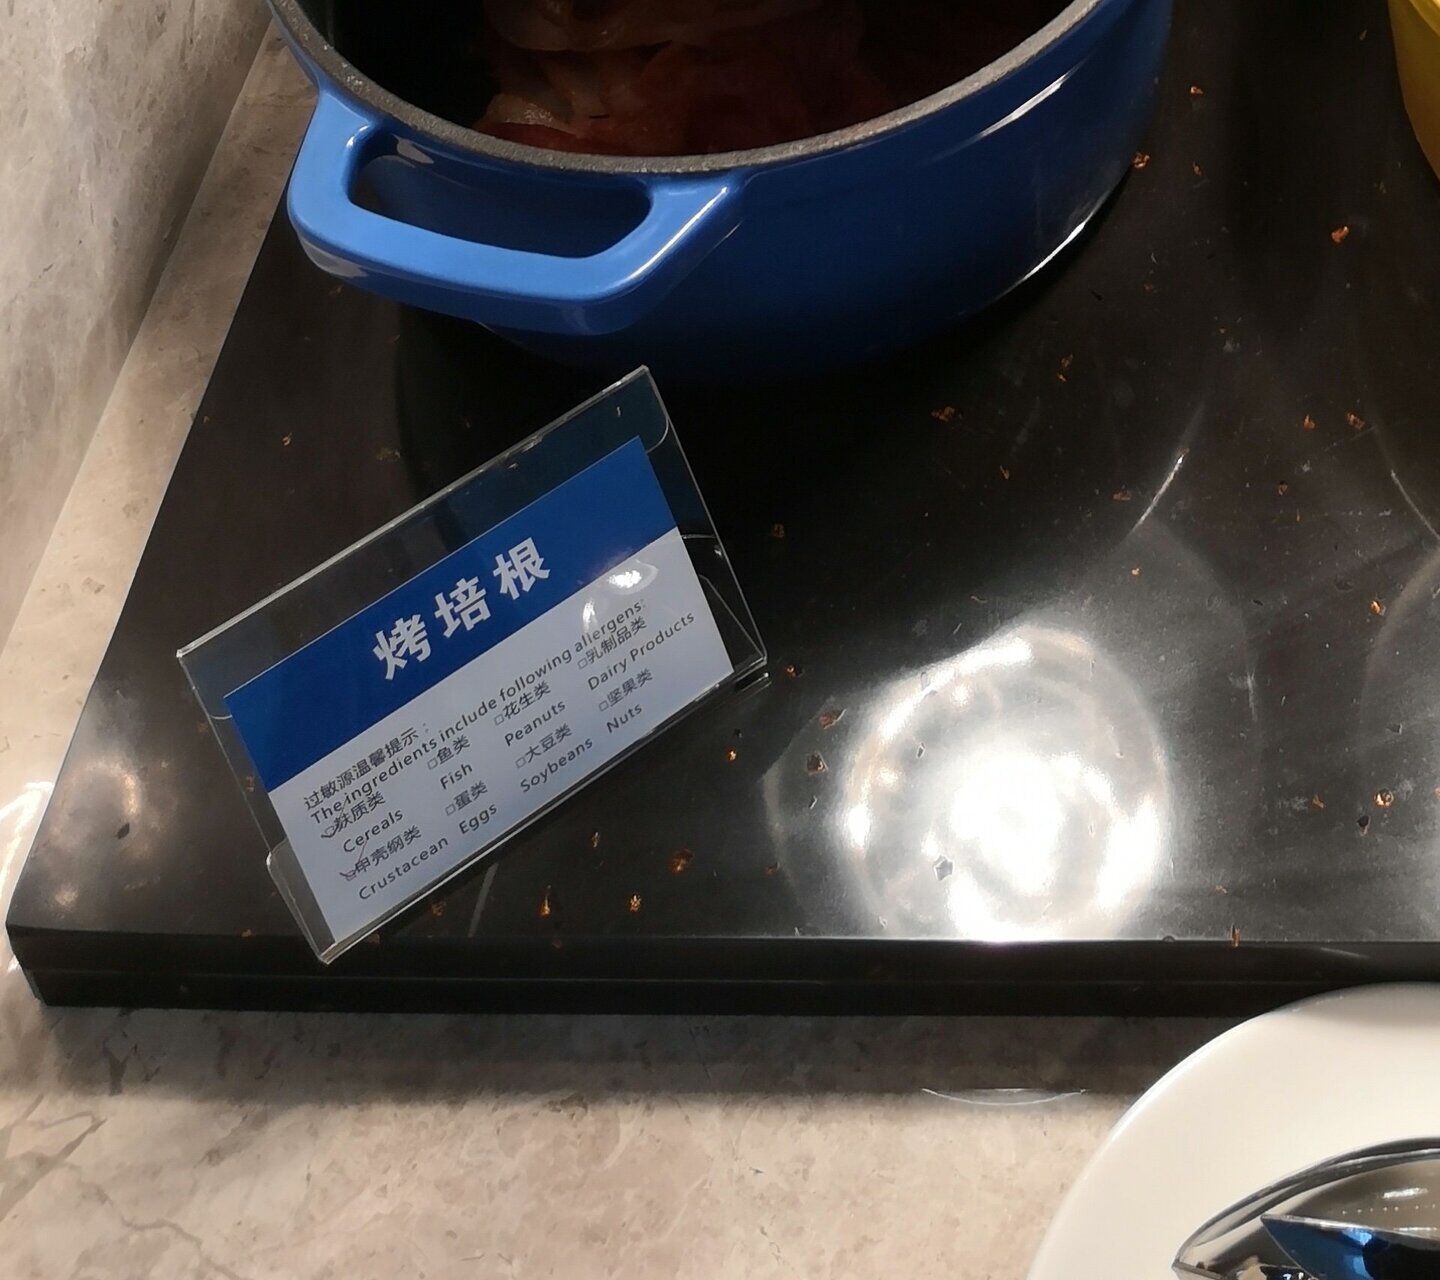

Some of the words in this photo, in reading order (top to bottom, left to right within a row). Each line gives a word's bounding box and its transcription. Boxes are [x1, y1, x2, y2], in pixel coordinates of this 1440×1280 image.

[373, 538, 551, 680] 烤培根
[586, 616, 648, 665] 乳制品类
[587, 658, 628, 691] Dairy
[630, 612, 695, 662] Products
[503, 681, 551, 721] 花生类
[608, 669, 653, 707] 坚果类
[311, 800, 342, 825] The
[344, 737, 438, 803] ingredients
[439, 697, 498, 742] include
[499, 649, 573, 702] following
[574, 599, 647, 653] allergens:
[504, 701, 567, 747] Peanuts
[606, 704, 643, 735] Nuts
[436, 734, 471, 766] 鱼类
[520, 737, 594, 793] Soybeans
[526, 723, 573, 765] 大豆类
[439, 762, 474, 790] Fish
[453, 781, 489, 811] 蛋类
[343, 810, 405, 853] Cereals
[459, 802, 498, 836] Eggs
[358, 836, 449, 902] Crustacean
